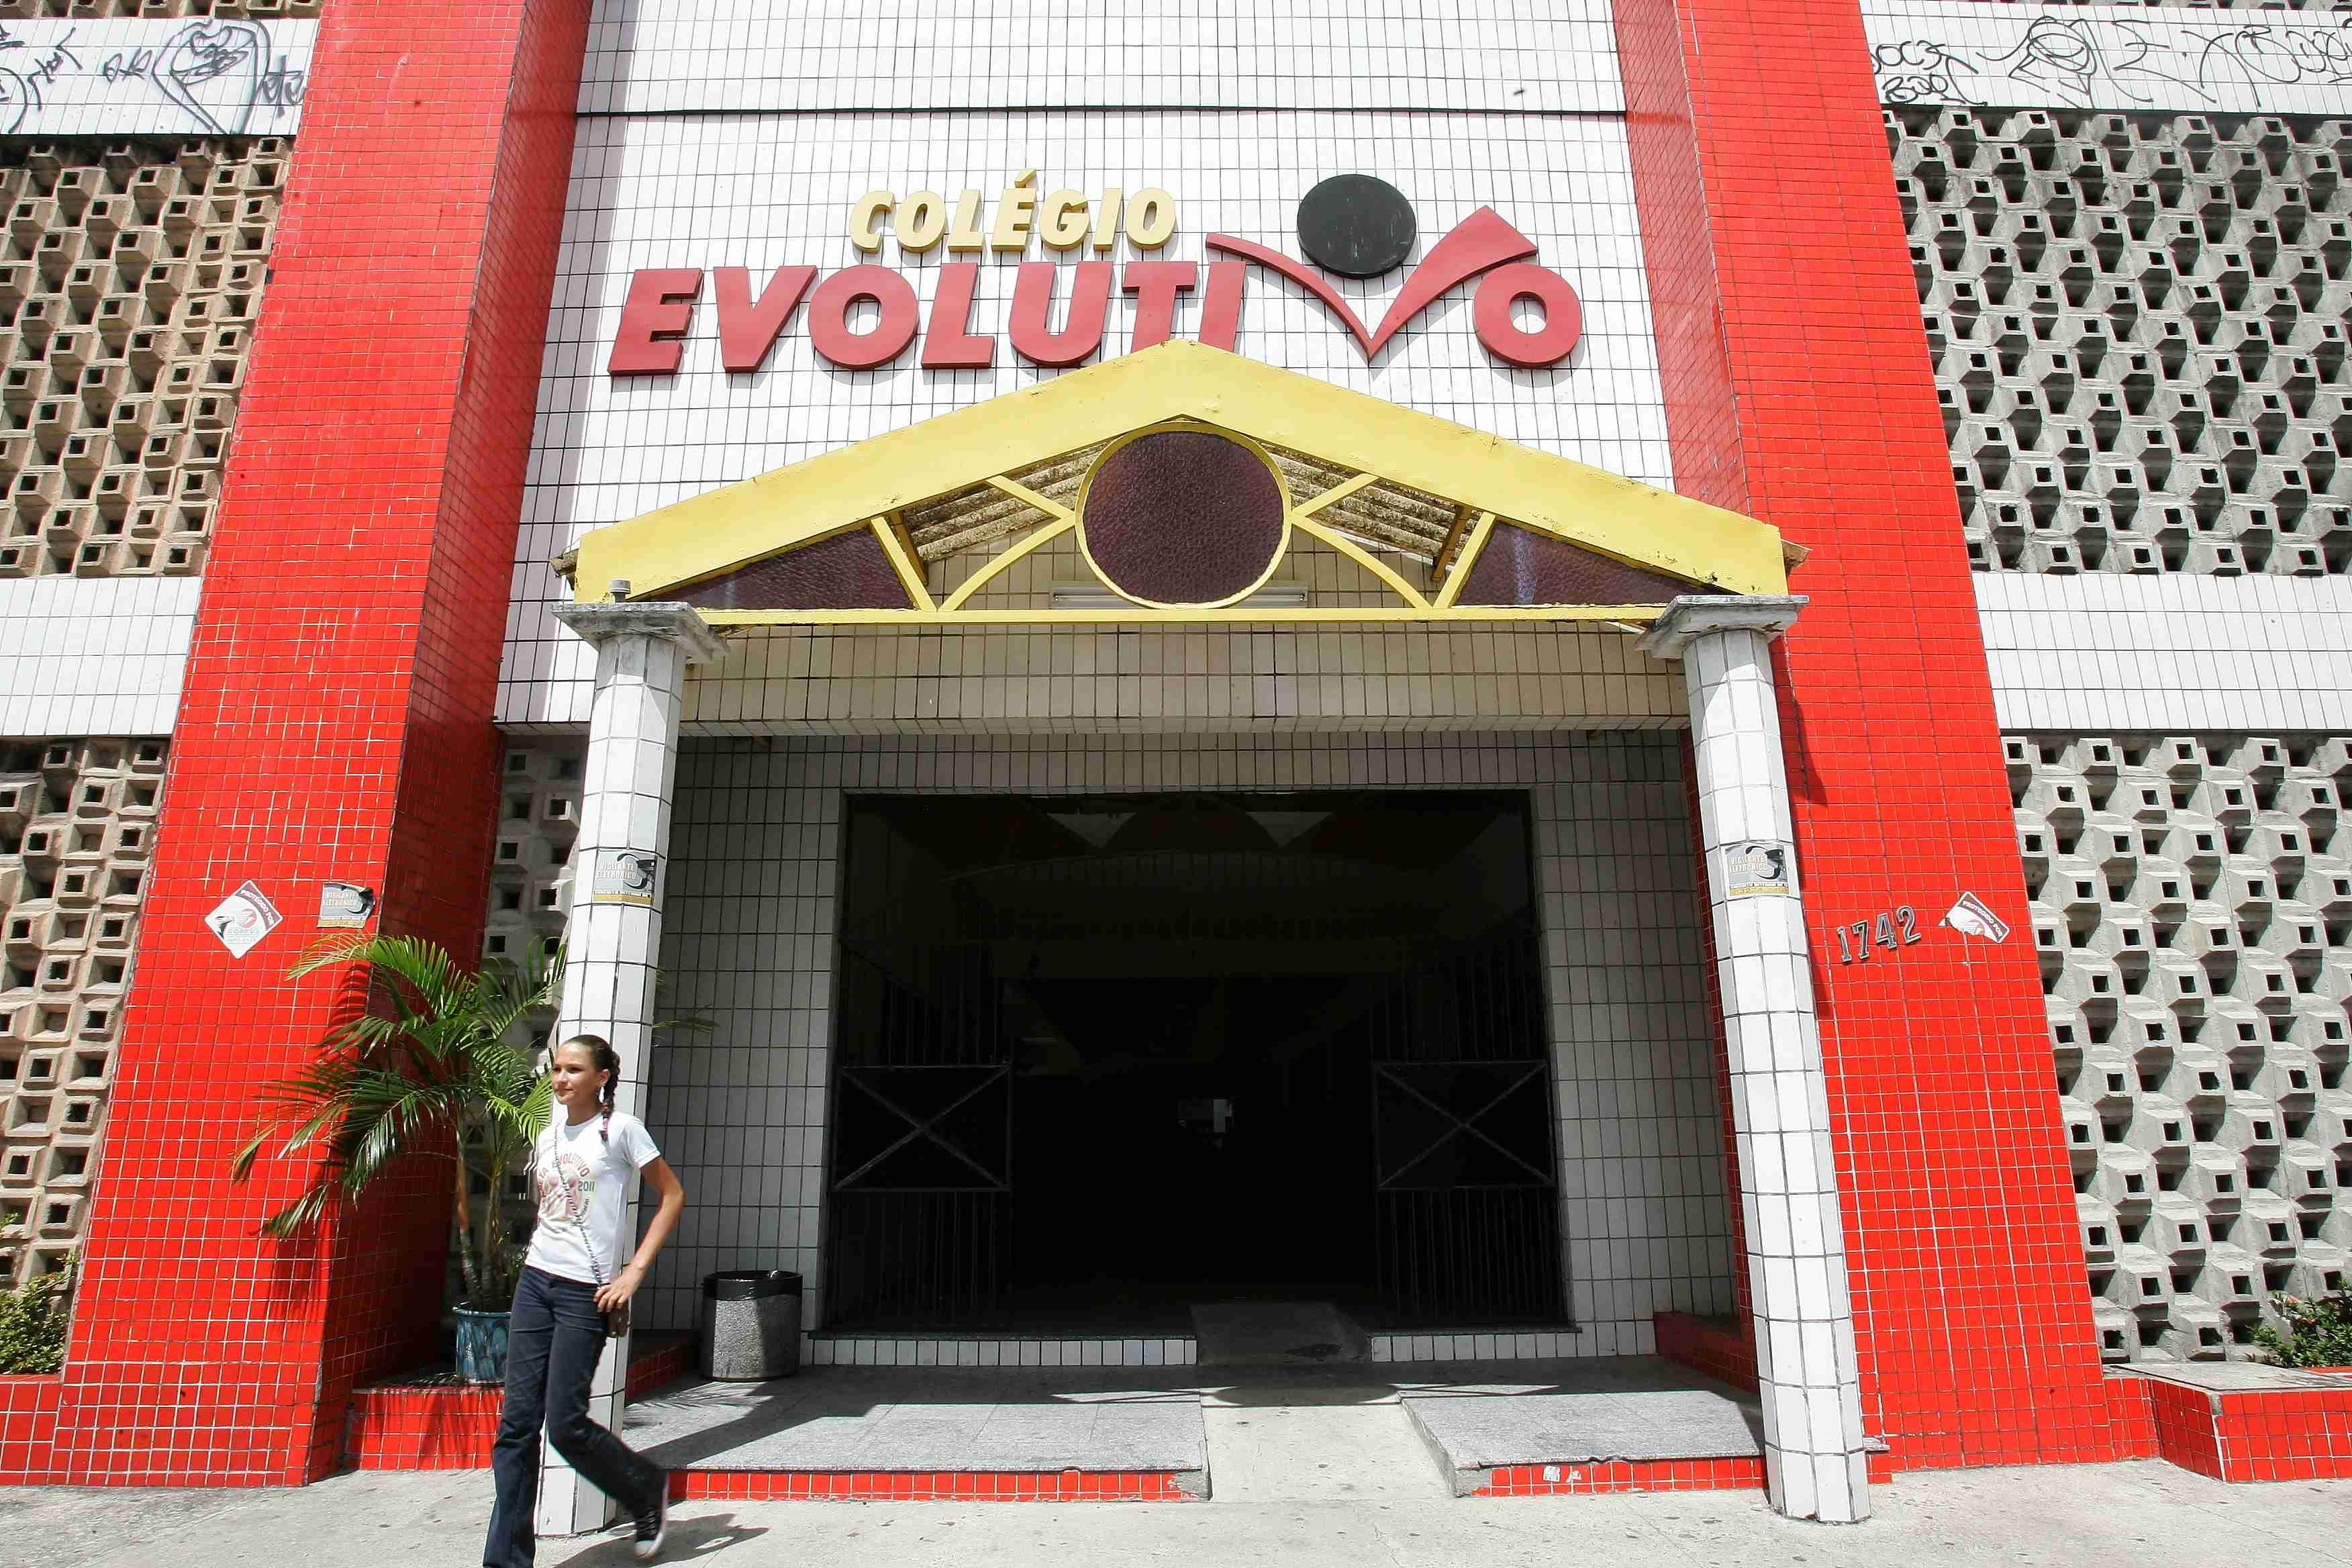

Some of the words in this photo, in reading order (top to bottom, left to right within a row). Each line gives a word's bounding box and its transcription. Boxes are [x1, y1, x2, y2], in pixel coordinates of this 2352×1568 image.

[849, 168, 1177, 254] COLÉGIO
[607, 204, 1583, 376] EVOLUTIVO
[1836, 905, 1922, 964] 1742
[577, 1181, 595, 1192] 2011
